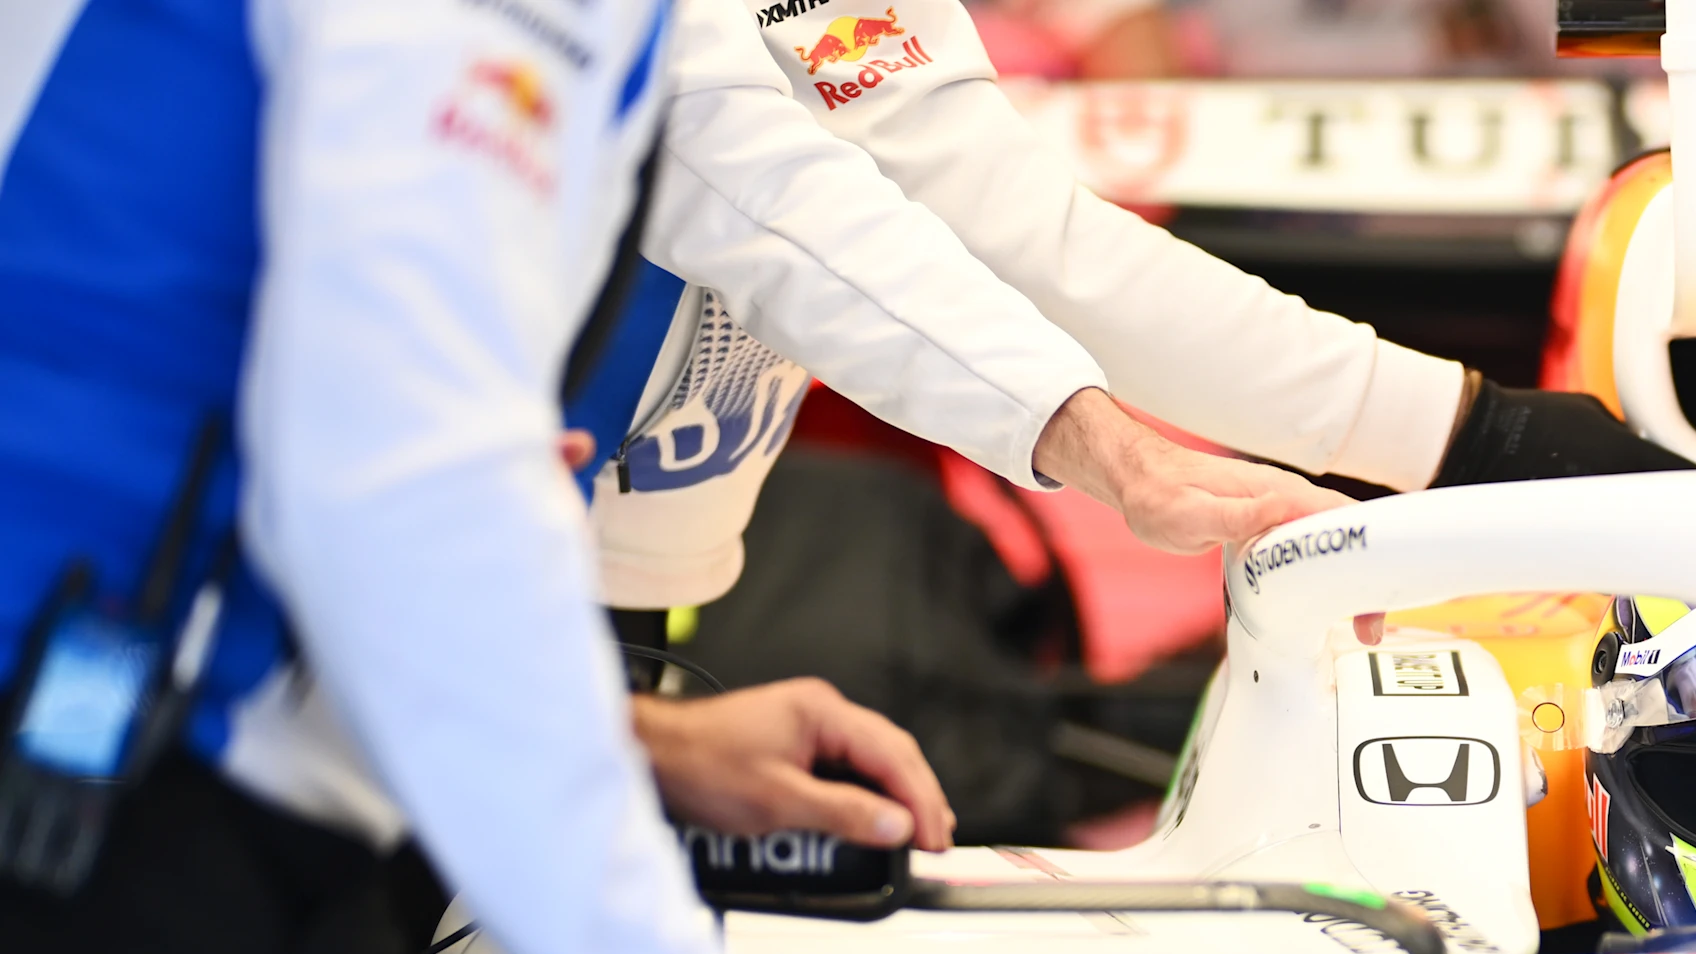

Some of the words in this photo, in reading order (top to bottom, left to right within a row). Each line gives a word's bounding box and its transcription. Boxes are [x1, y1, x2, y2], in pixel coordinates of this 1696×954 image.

[814, 64, 884, 111] Red
[868, 36, 934, 73] Bull
[1255, 525, 1368, 576] STUDENT.COM
[1621, 650, 1650, 667] Mobil
